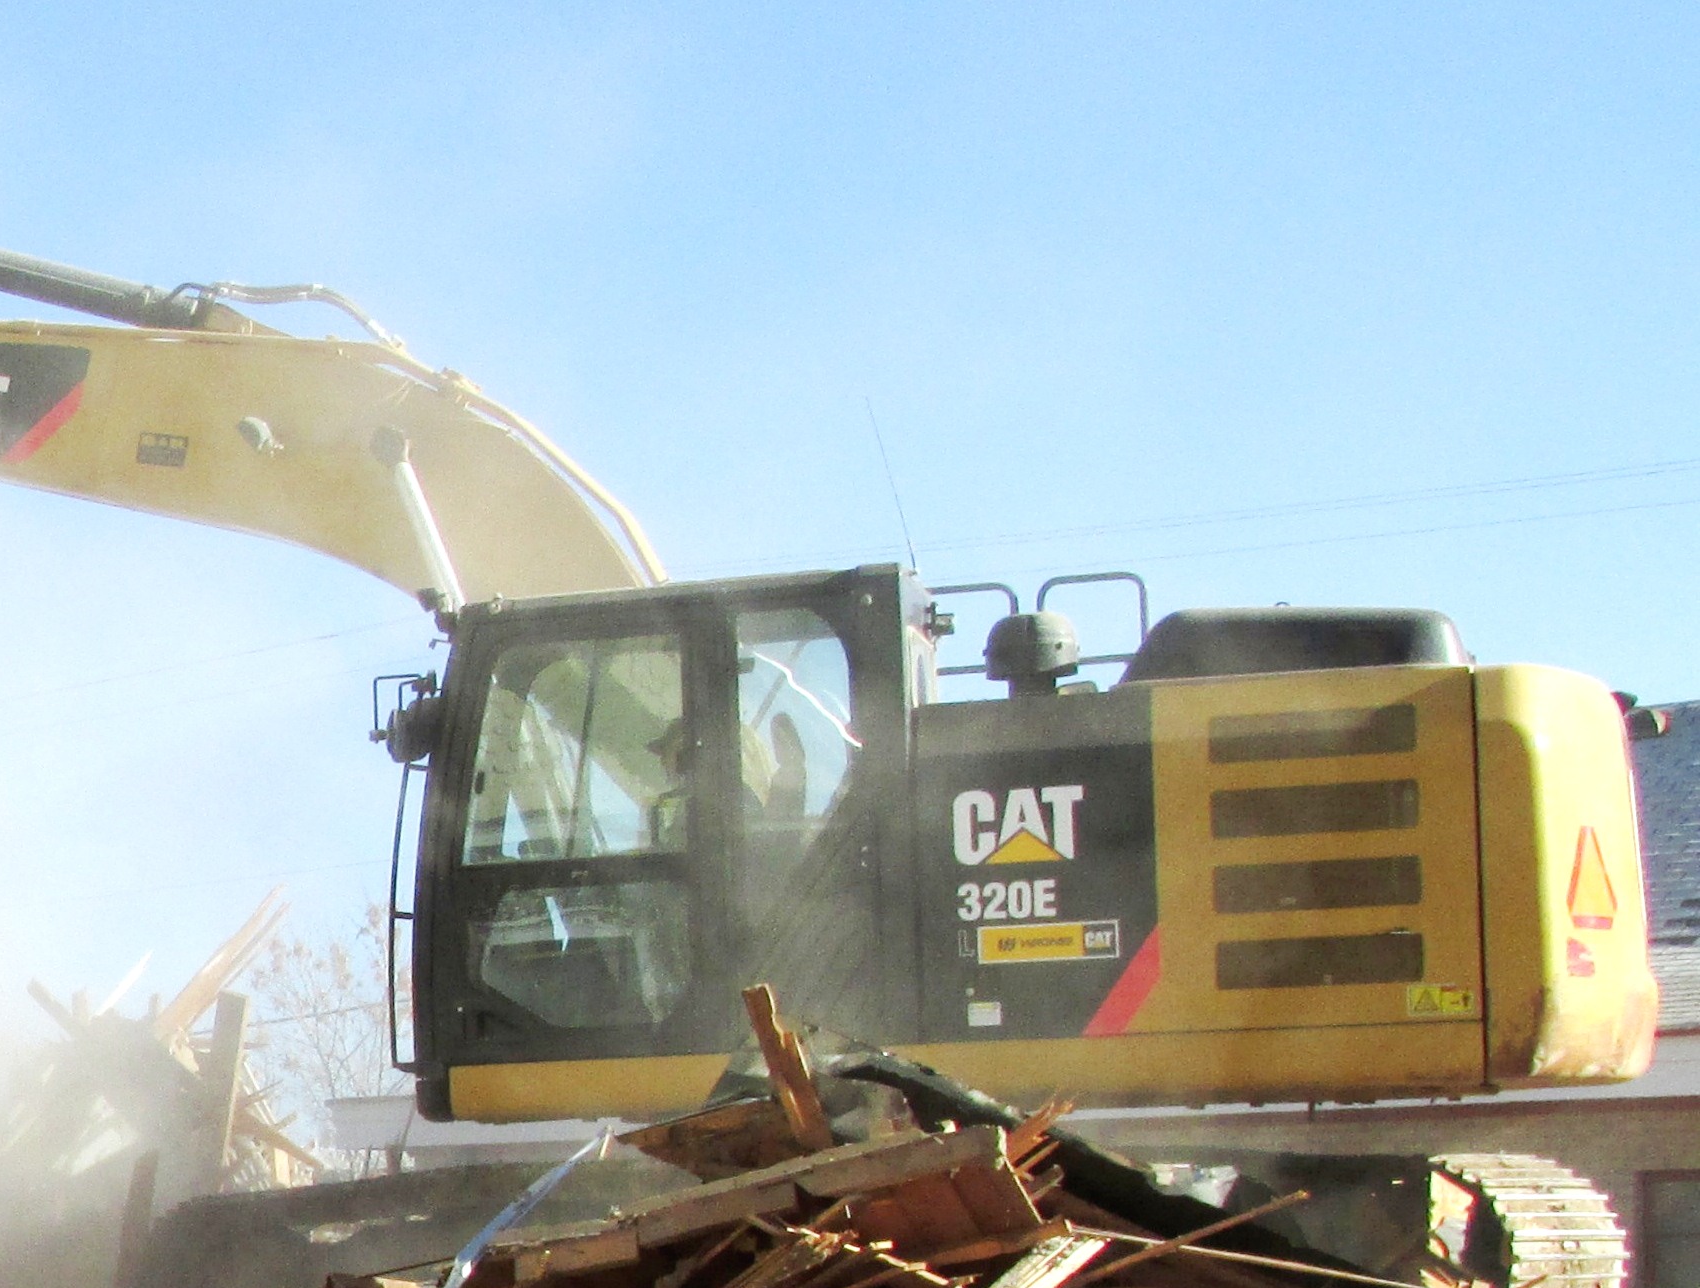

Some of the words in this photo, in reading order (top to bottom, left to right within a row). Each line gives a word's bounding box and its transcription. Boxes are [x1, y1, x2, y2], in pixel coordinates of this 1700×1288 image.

[952, 785, 1084, 866] CAT
[956, 879, 1058, 921] 320E
[1084, 930, 1113, 948] CAT
